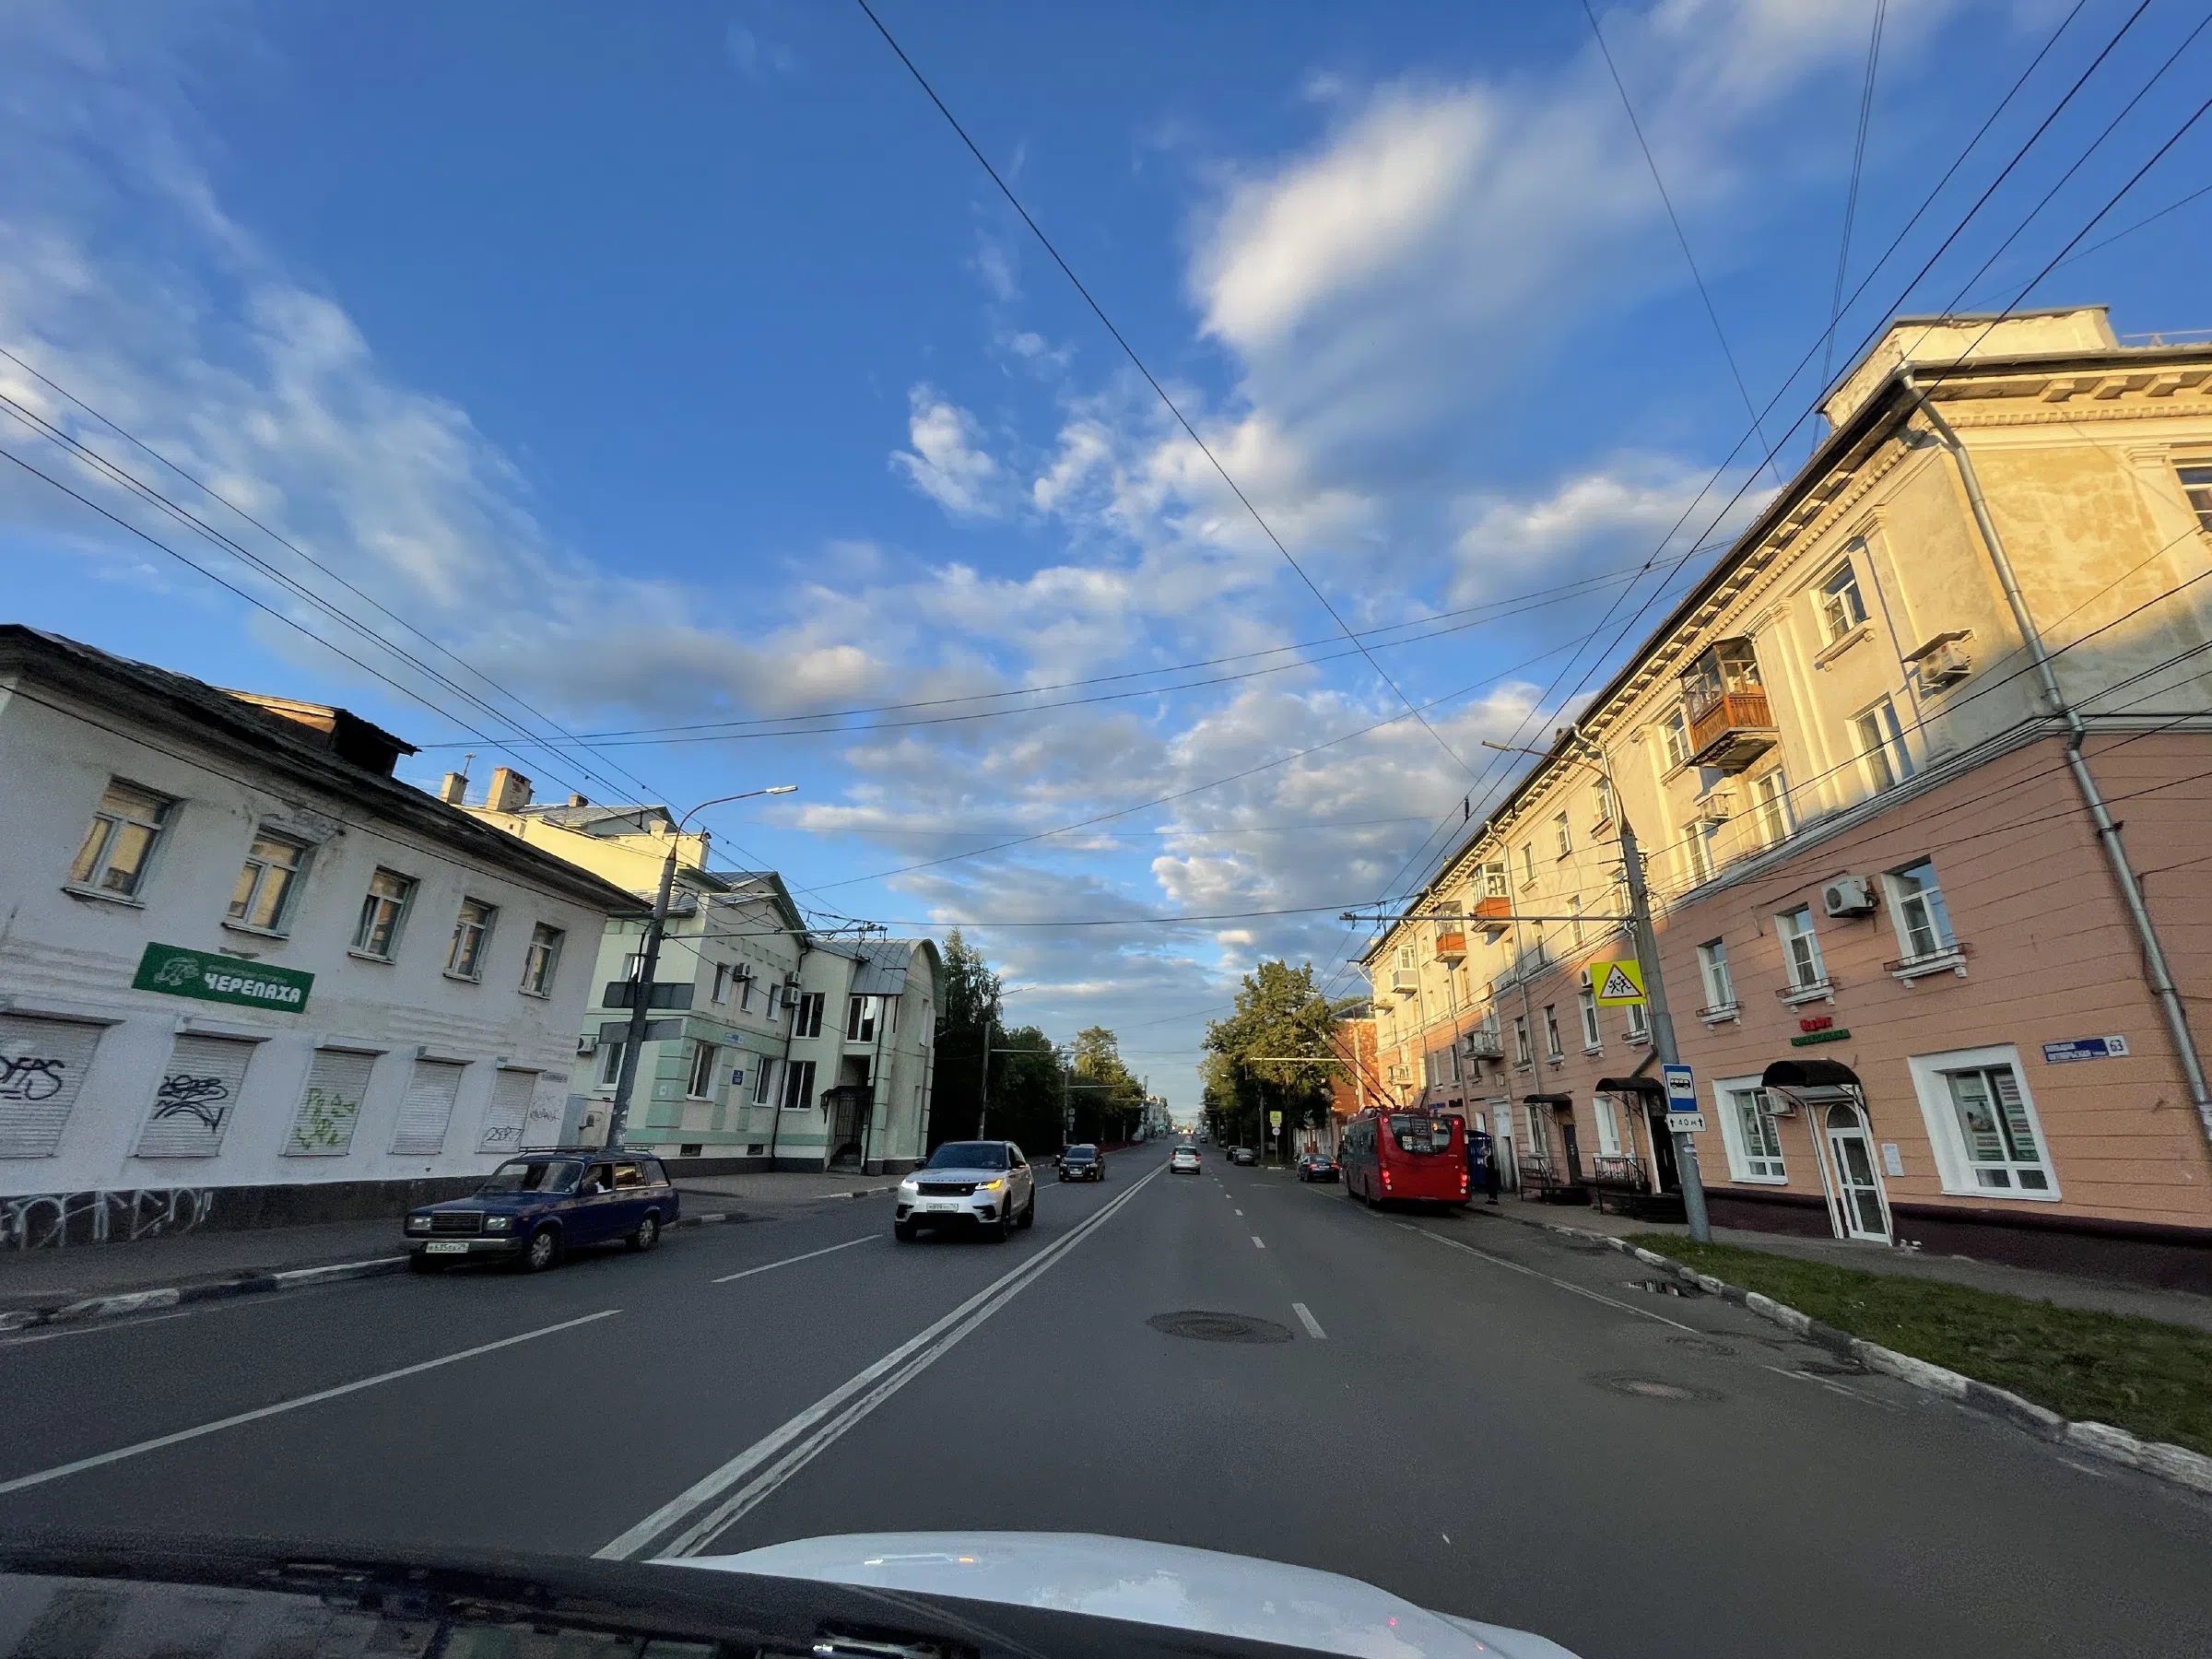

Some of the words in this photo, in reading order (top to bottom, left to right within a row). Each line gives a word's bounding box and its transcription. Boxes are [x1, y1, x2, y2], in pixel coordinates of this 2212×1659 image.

[204, 972, 302, 1004] ЧЕРЕПАХА
[2110, 1039, 2124, 1052] 63
[1677, 1118, 1689, 1126] 40
